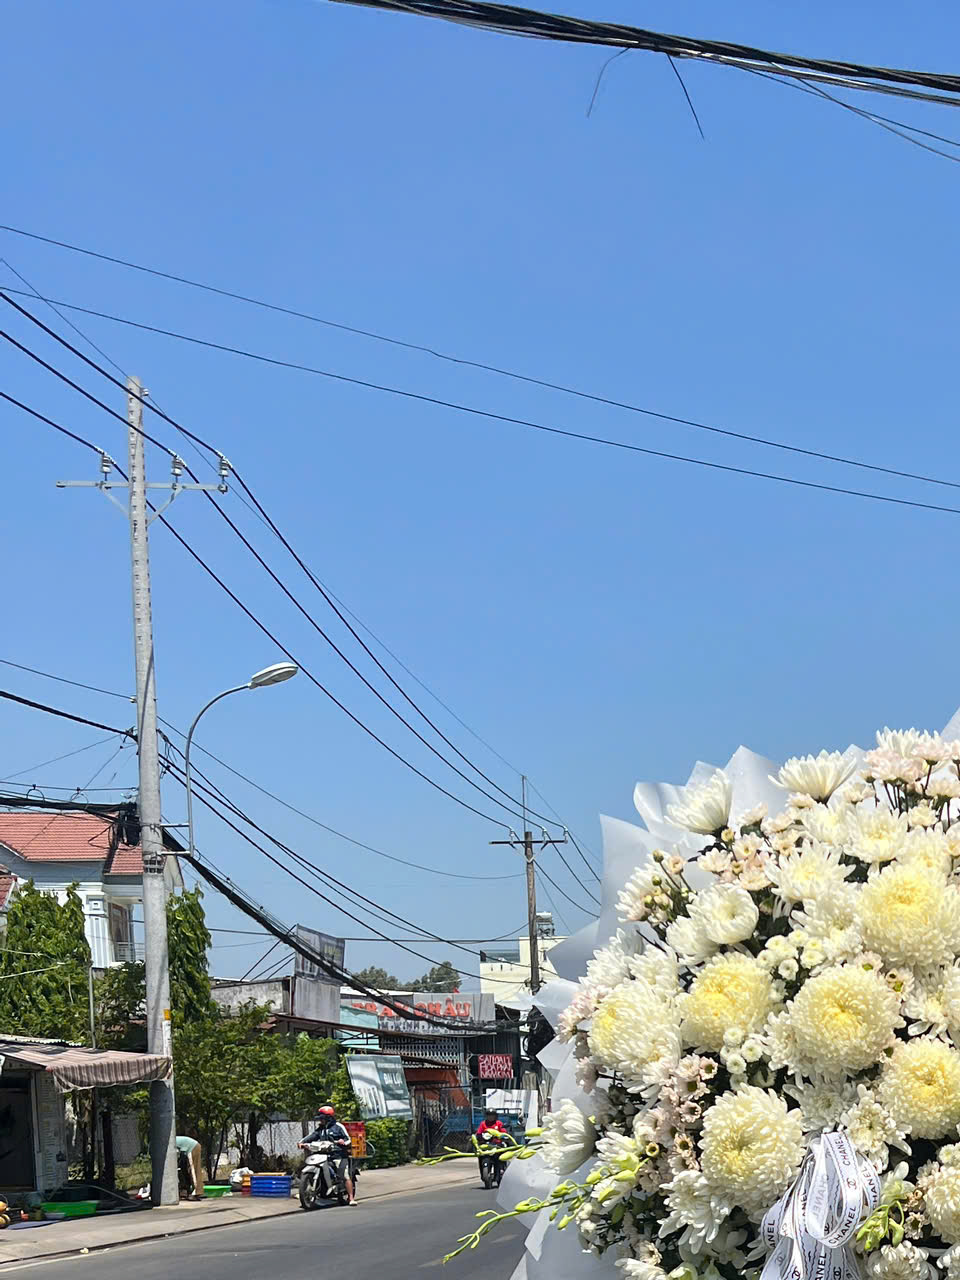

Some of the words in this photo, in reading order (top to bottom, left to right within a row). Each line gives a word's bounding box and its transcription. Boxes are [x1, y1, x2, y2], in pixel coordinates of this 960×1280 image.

[836, 1136, 851, 1166] CHANEL
[862, 1166, 879, 1211] HANEL
[828, 1205, 858, 1244] CHANEL
